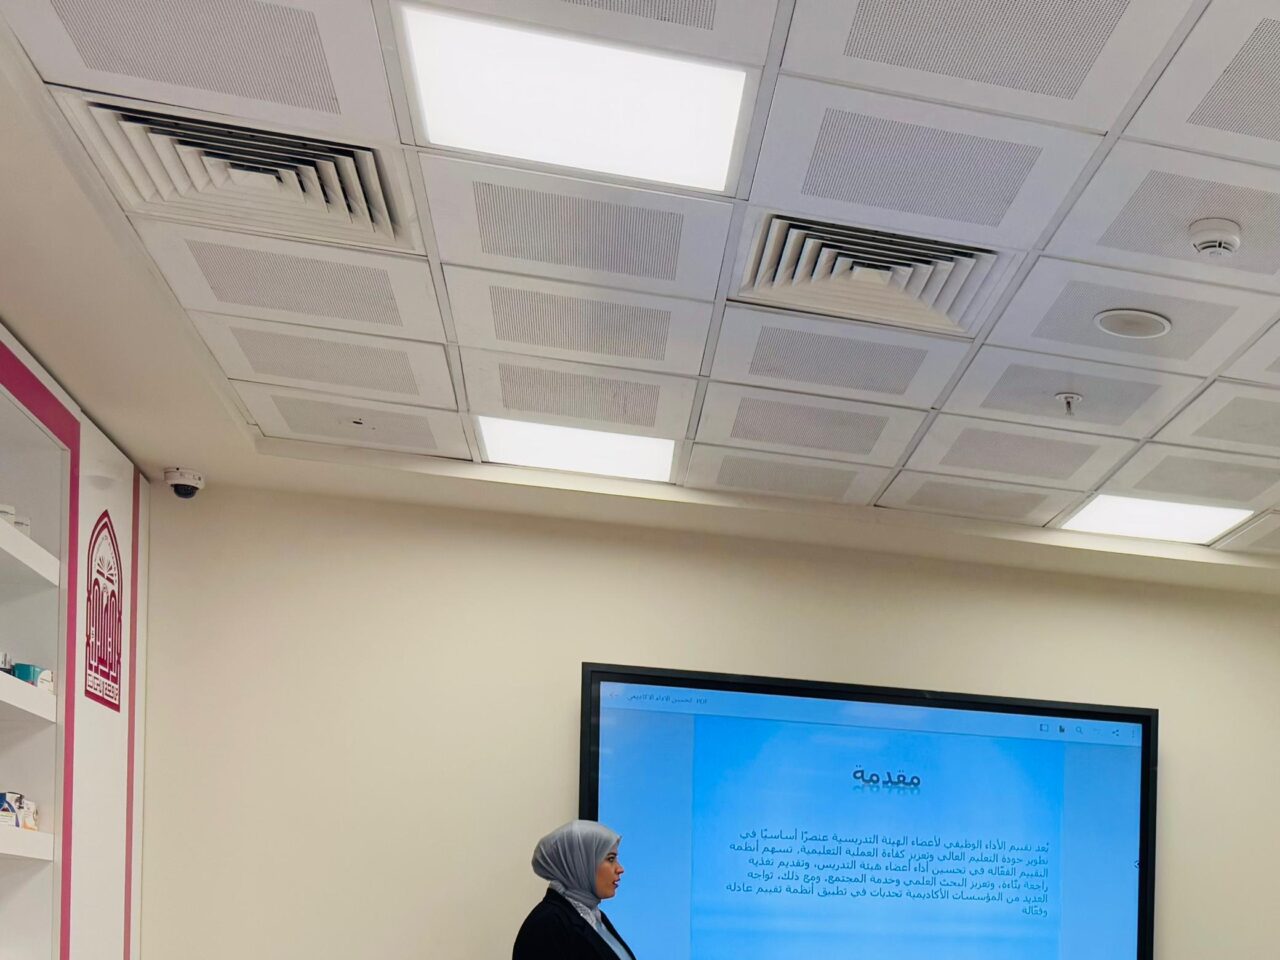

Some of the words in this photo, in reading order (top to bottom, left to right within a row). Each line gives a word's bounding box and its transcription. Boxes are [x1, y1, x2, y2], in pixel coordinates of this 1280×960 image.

[852, 763, 921, 789] مقدمة
[739, 829, 757, 840] في
[969, 867, 985, 876] في
[803, 873, 821, 883] ومع
[851, 887, 867, 898] في
[1006, 895, 1020, 903] من
